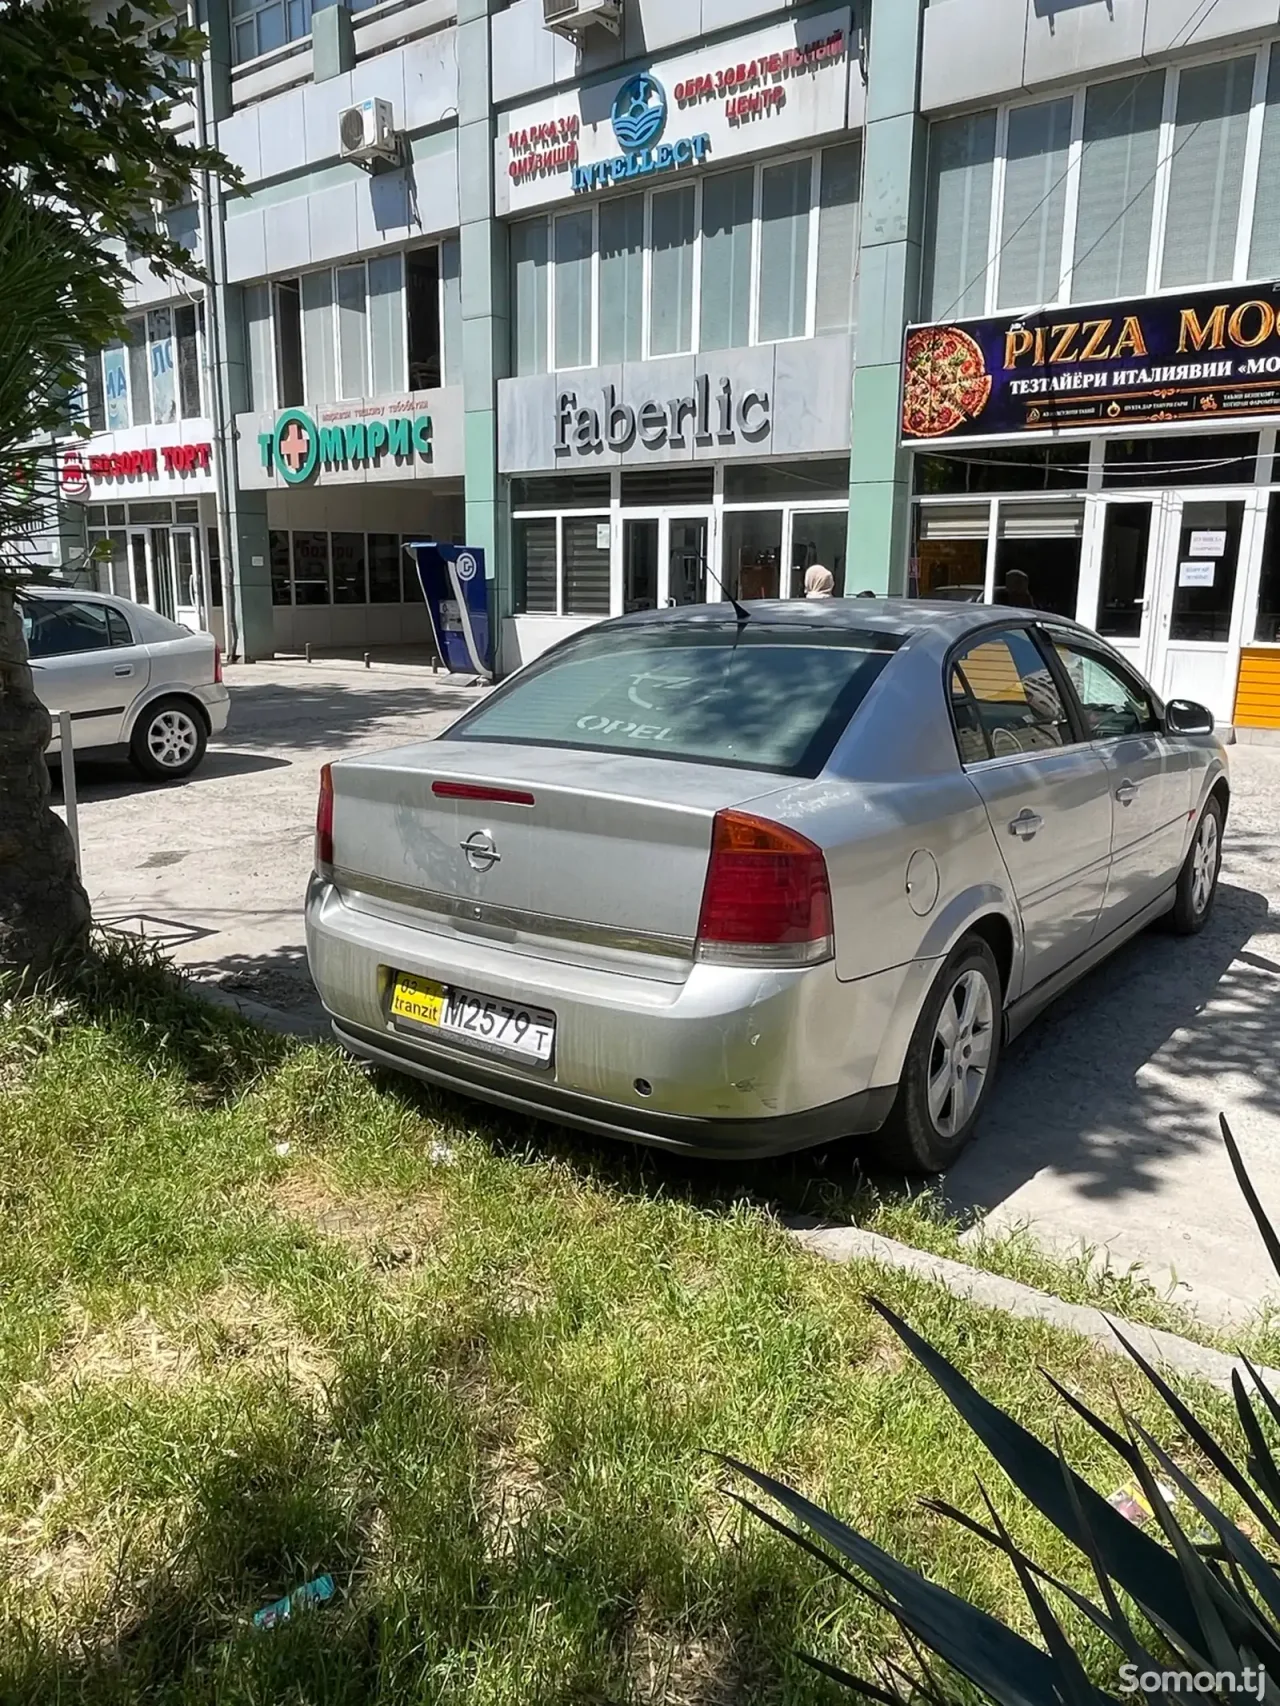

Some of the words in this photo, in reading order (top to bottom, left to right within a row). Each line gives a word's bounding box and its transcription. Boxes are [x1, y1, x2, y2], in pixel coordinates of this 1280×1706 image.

[674, 29, 845, 100] ОБРАЗОВАТЕЛЬНЫЙ
[725, 85, 785, 119] ЦЕНТР
[509, 114, 579, 148] МАРКАЗИ
[571, 132, 711, 190] INTELLECT
[1002, 316, 1149, 370] PIZZA
[1176, 300, 1280, 354] MO
[1010, 372, 1108, 395] ТЕЗТАЙЁРИ
[1112, 361, 1233, 386] ИТАЛИЯВИИ
[553, 374, 771, 449] faberlic
[161, 443, 212, 472] ТОРТ
[576, 714, 673, 742] OPEL
[394, 995, 438, 1021] tranzit
[444, 991, 531, 1044] M2579
